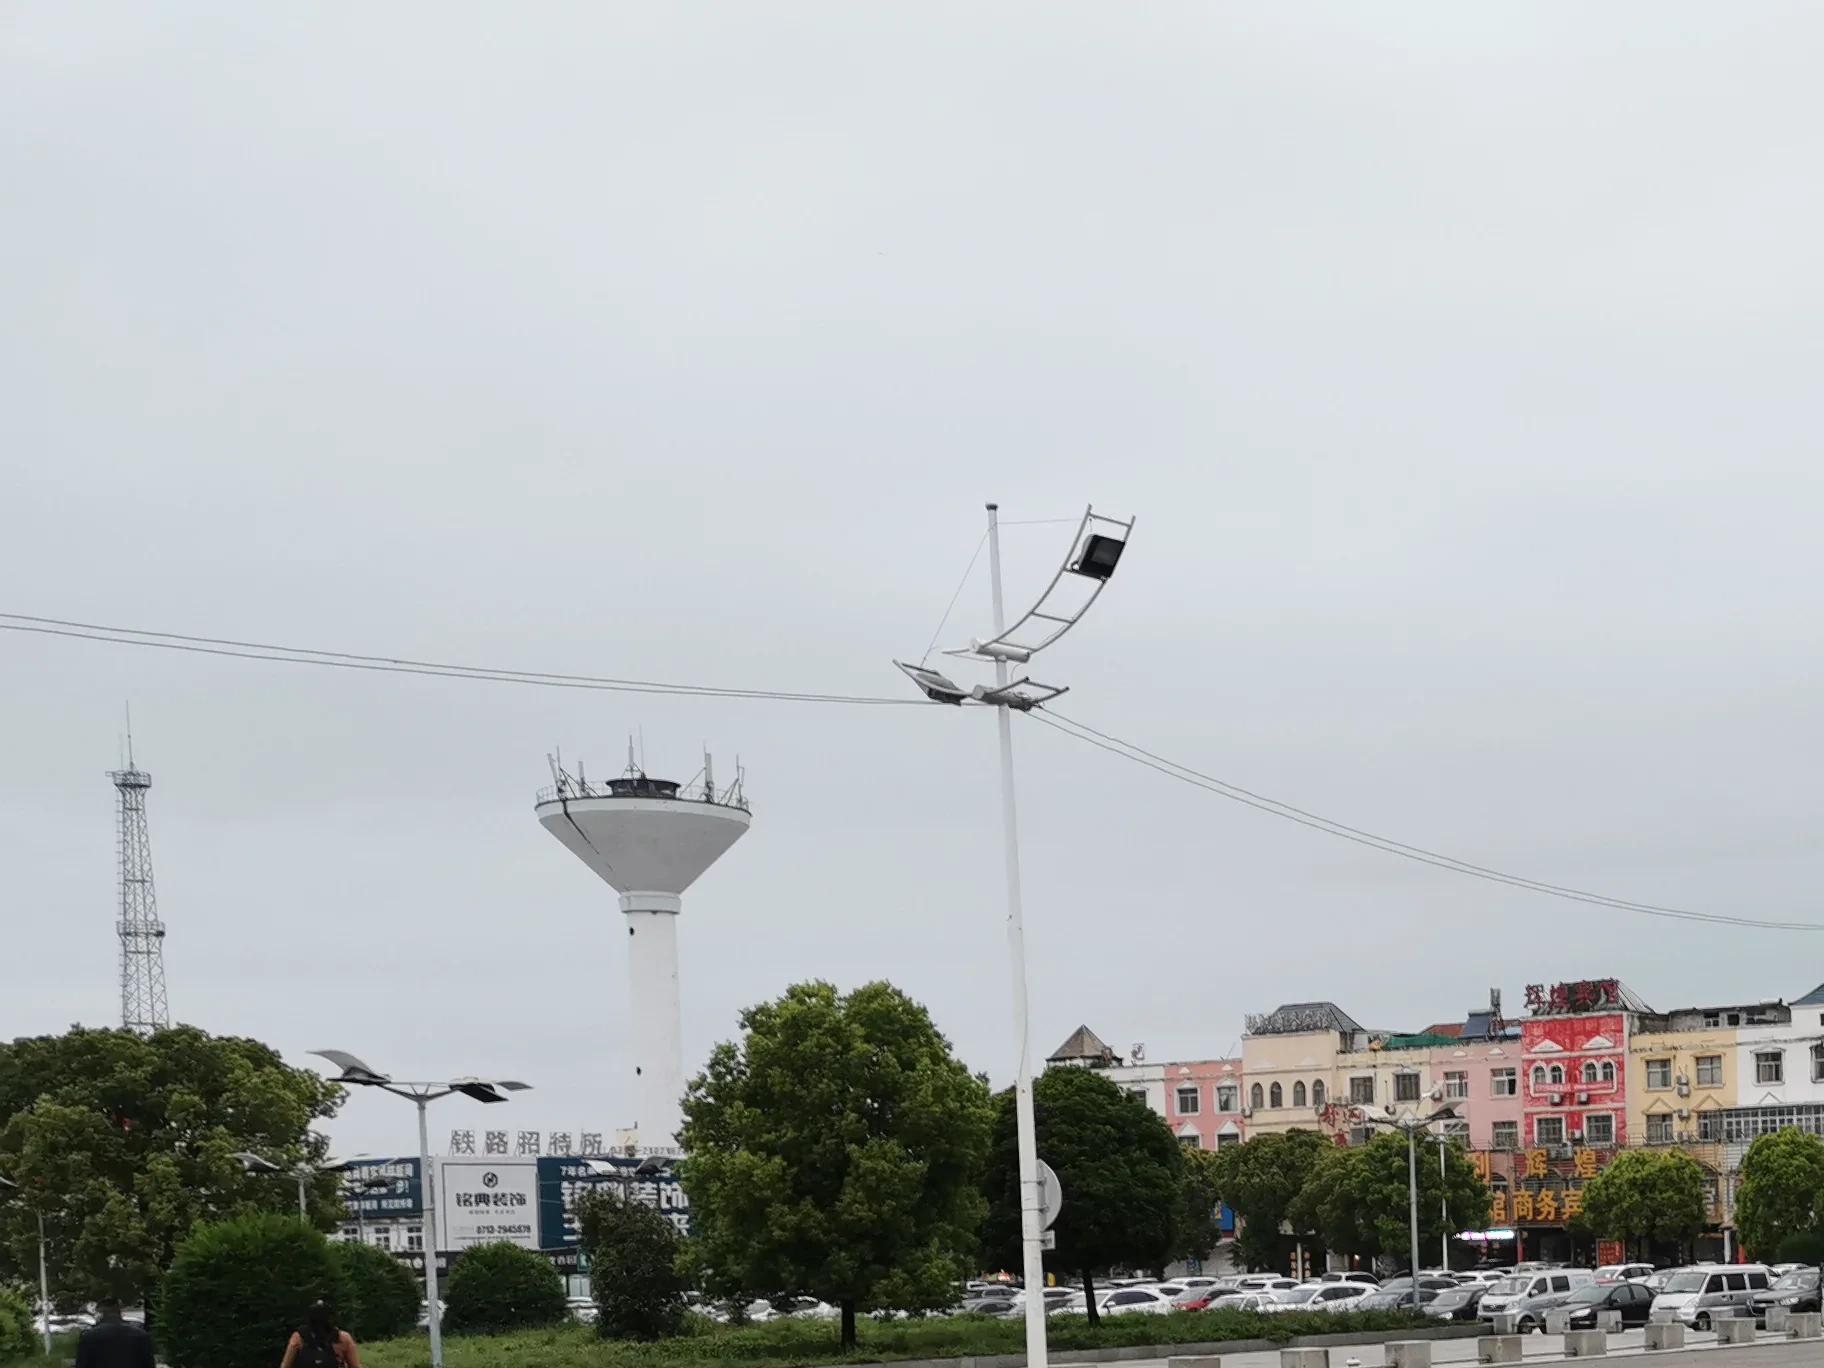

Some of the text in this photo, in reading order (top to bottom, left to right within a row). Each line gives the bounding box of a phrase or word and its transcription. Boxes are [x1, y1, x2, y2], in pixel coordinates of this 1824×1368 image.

[450, 1130, 602, 1155] 铁路招待所
